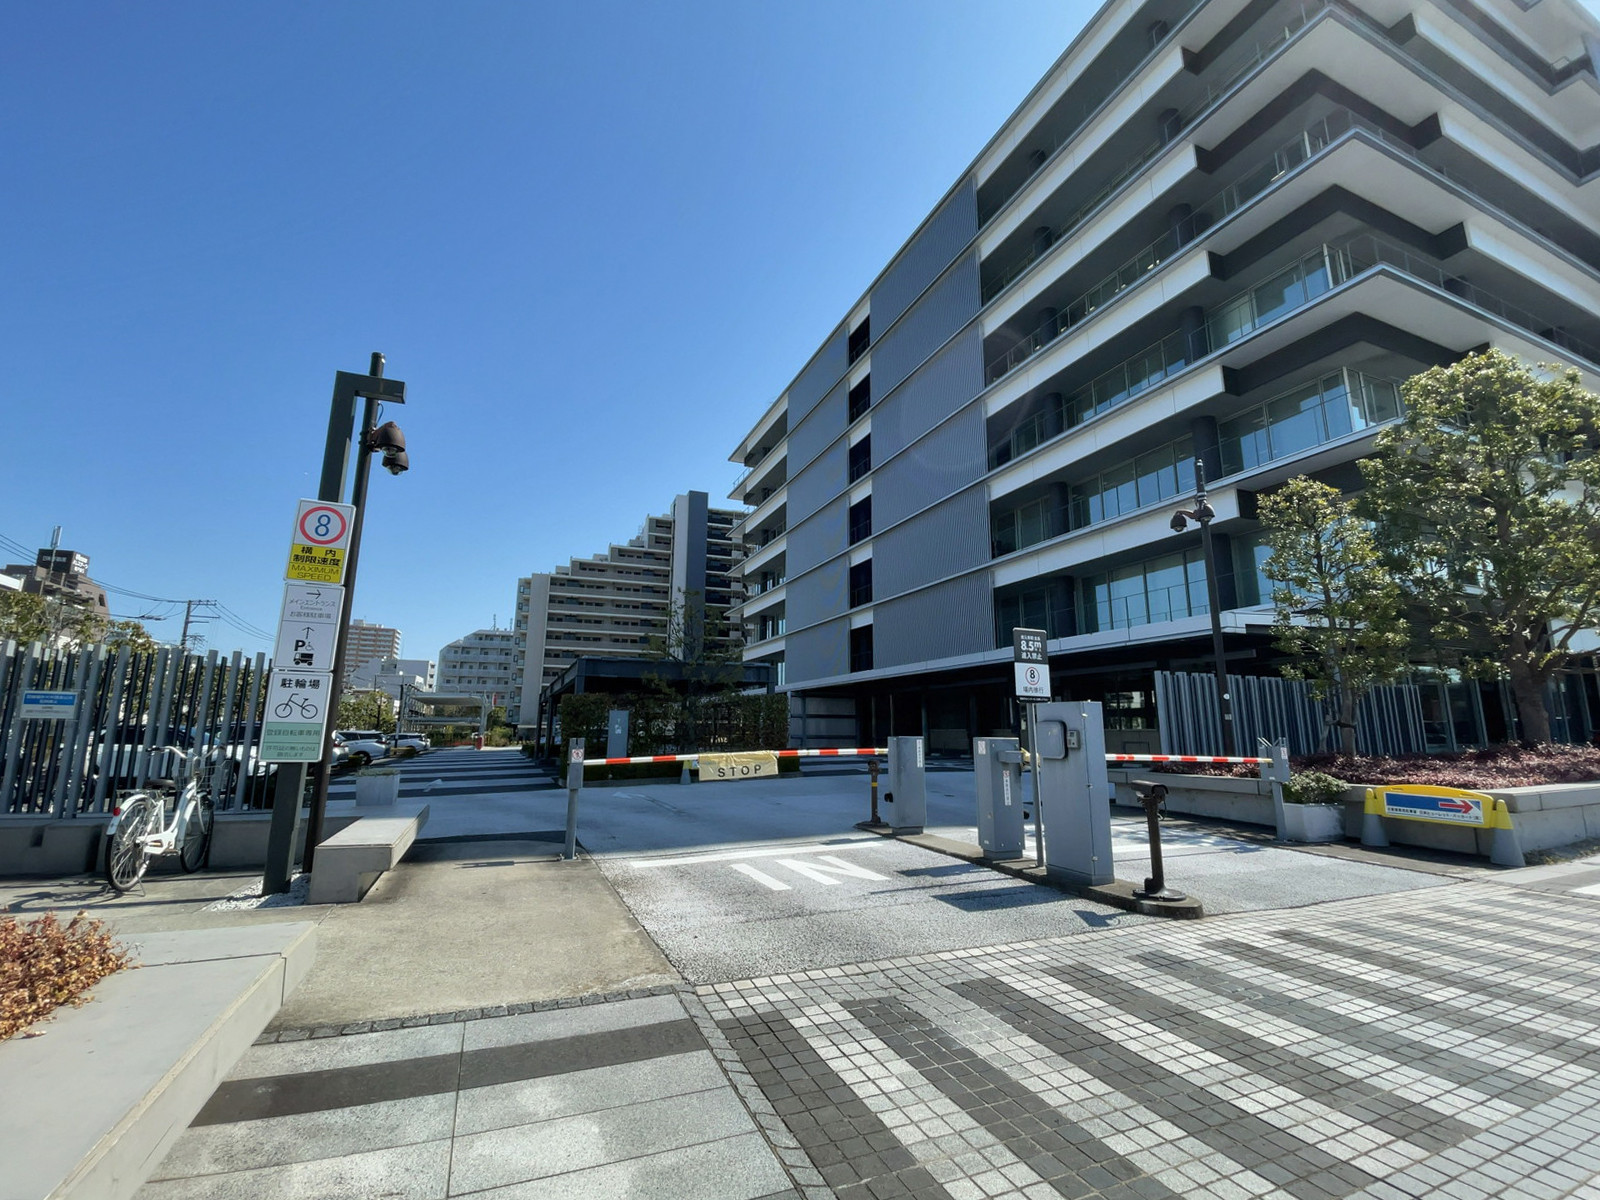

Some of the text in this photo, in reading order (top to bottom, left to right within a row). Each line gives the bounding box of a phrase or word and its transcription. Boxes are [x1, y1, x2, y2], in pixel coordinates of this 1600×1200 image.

[315, 514, 331, 537] 8
[293, 554, 340, 567] 制限速度
[291, 564, 339, 575] MAXIMUM
[296, 571, 332, 581] SPEED
[280, 678, 320, 689] 駐輪場
[717, 764, 761, 777] STOP
[730, 855, 891, 890] IN
